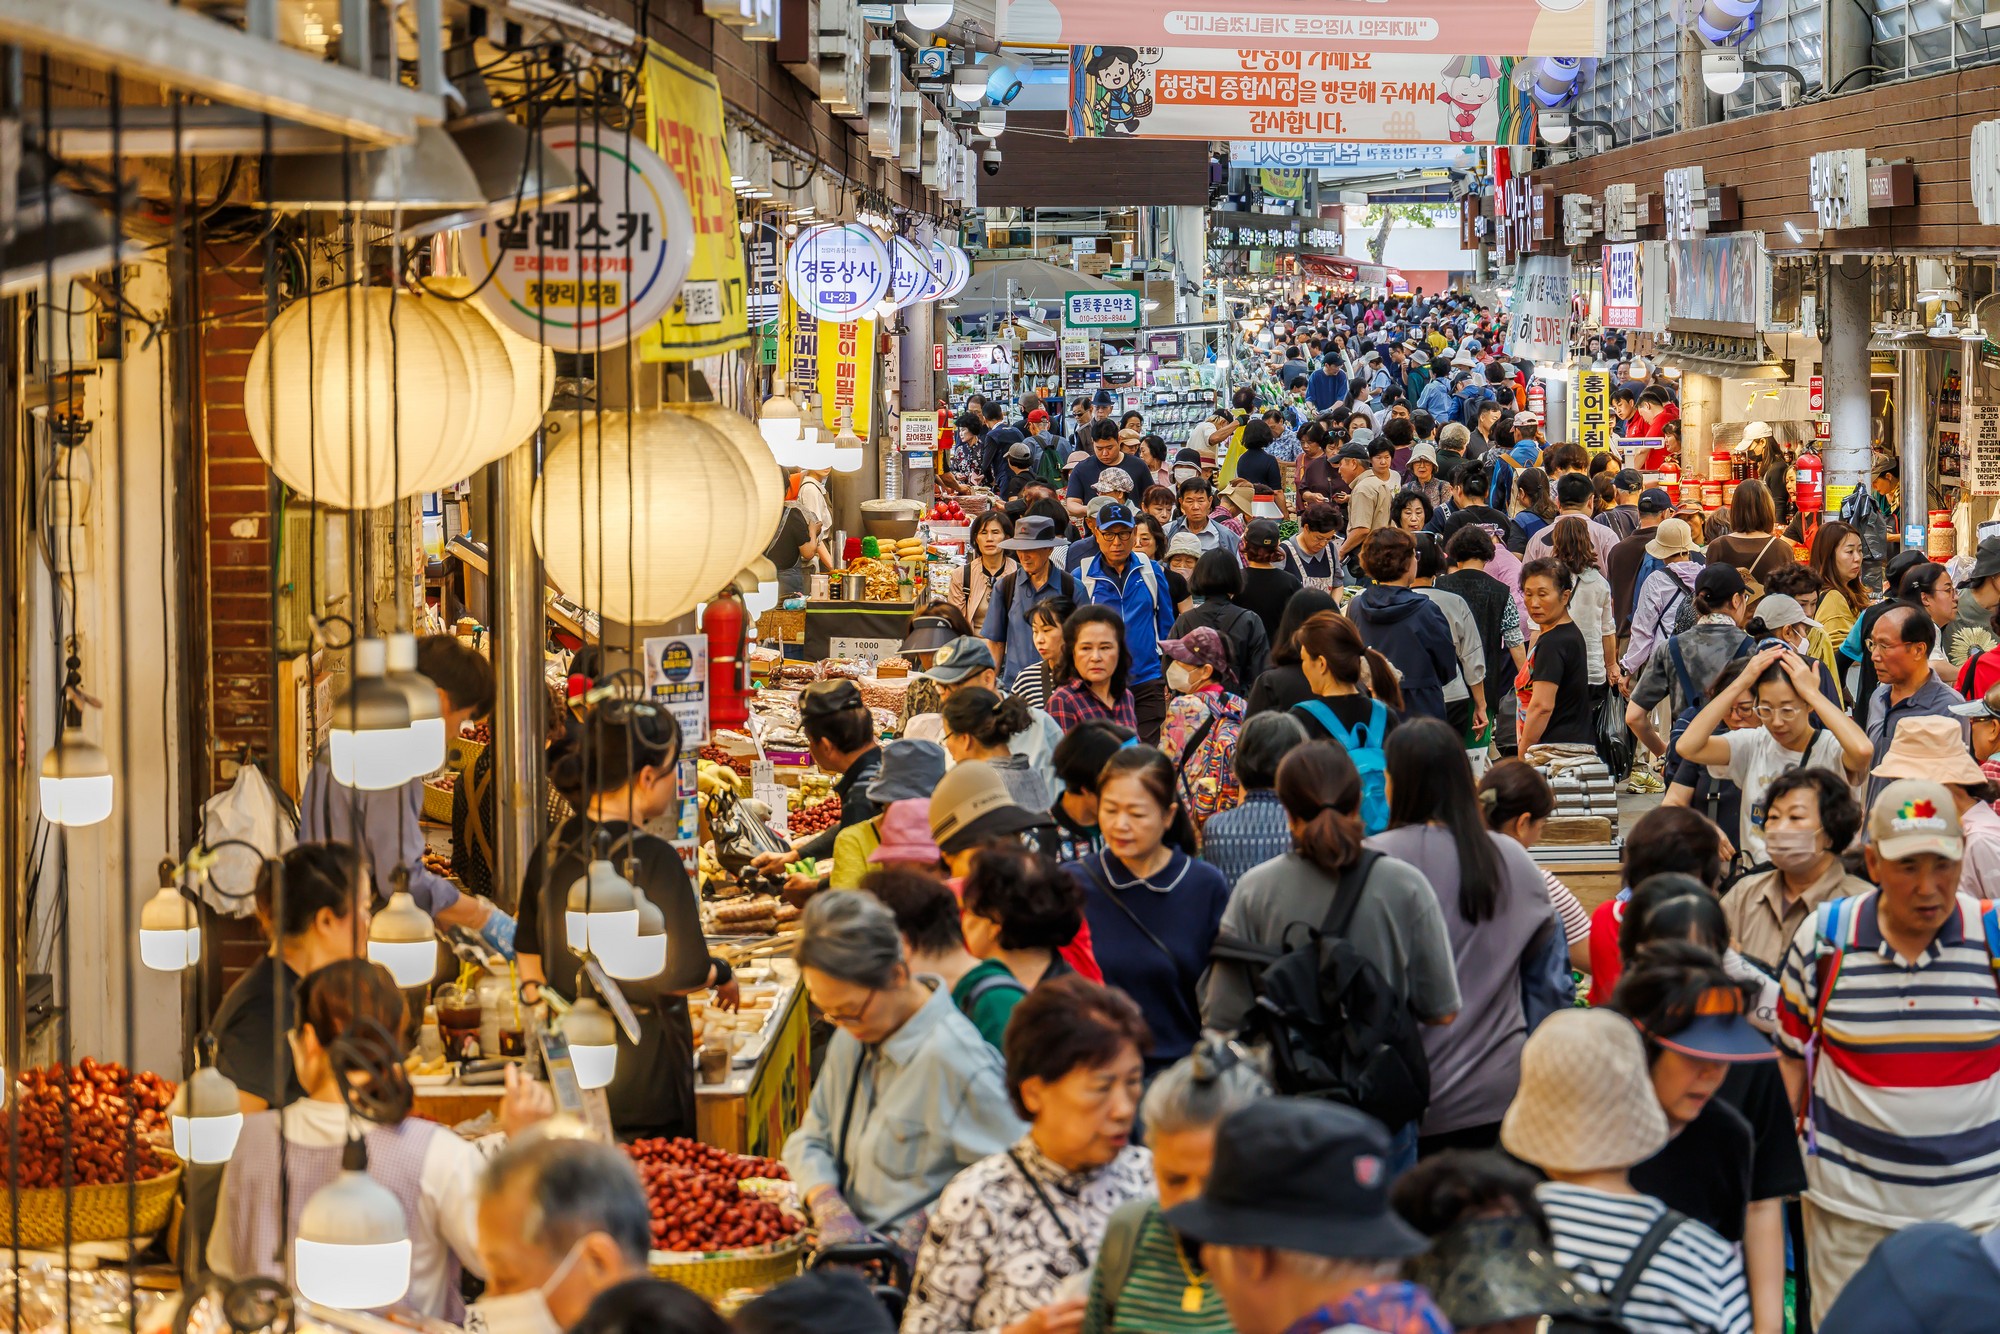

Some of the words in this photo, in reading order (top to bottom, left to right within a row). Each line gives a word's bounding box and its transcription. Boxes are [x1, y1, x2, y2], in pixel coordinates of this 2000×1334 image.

[1159, 73, 1216, 100] 청량리
[1219, 75, 1317, 105] 종합시장을
[1320, 79, 1377, 105] 방문해
[1380, 80, 1436, 105] 주셔서
[1248, 110, 1347, 135] 감사합니다.
[495, 210, 653, 252] 알래스카
[800, 260, 877, 284] 경동상사
[1583, 375, 1606, 448] 홍어무침
[905, 424, 934, 433] 환급행사
[905, 433, 934, 442] 참여점포
[1110, 505, 1122, 519] R
[854, 641, 879, 649] 10000
